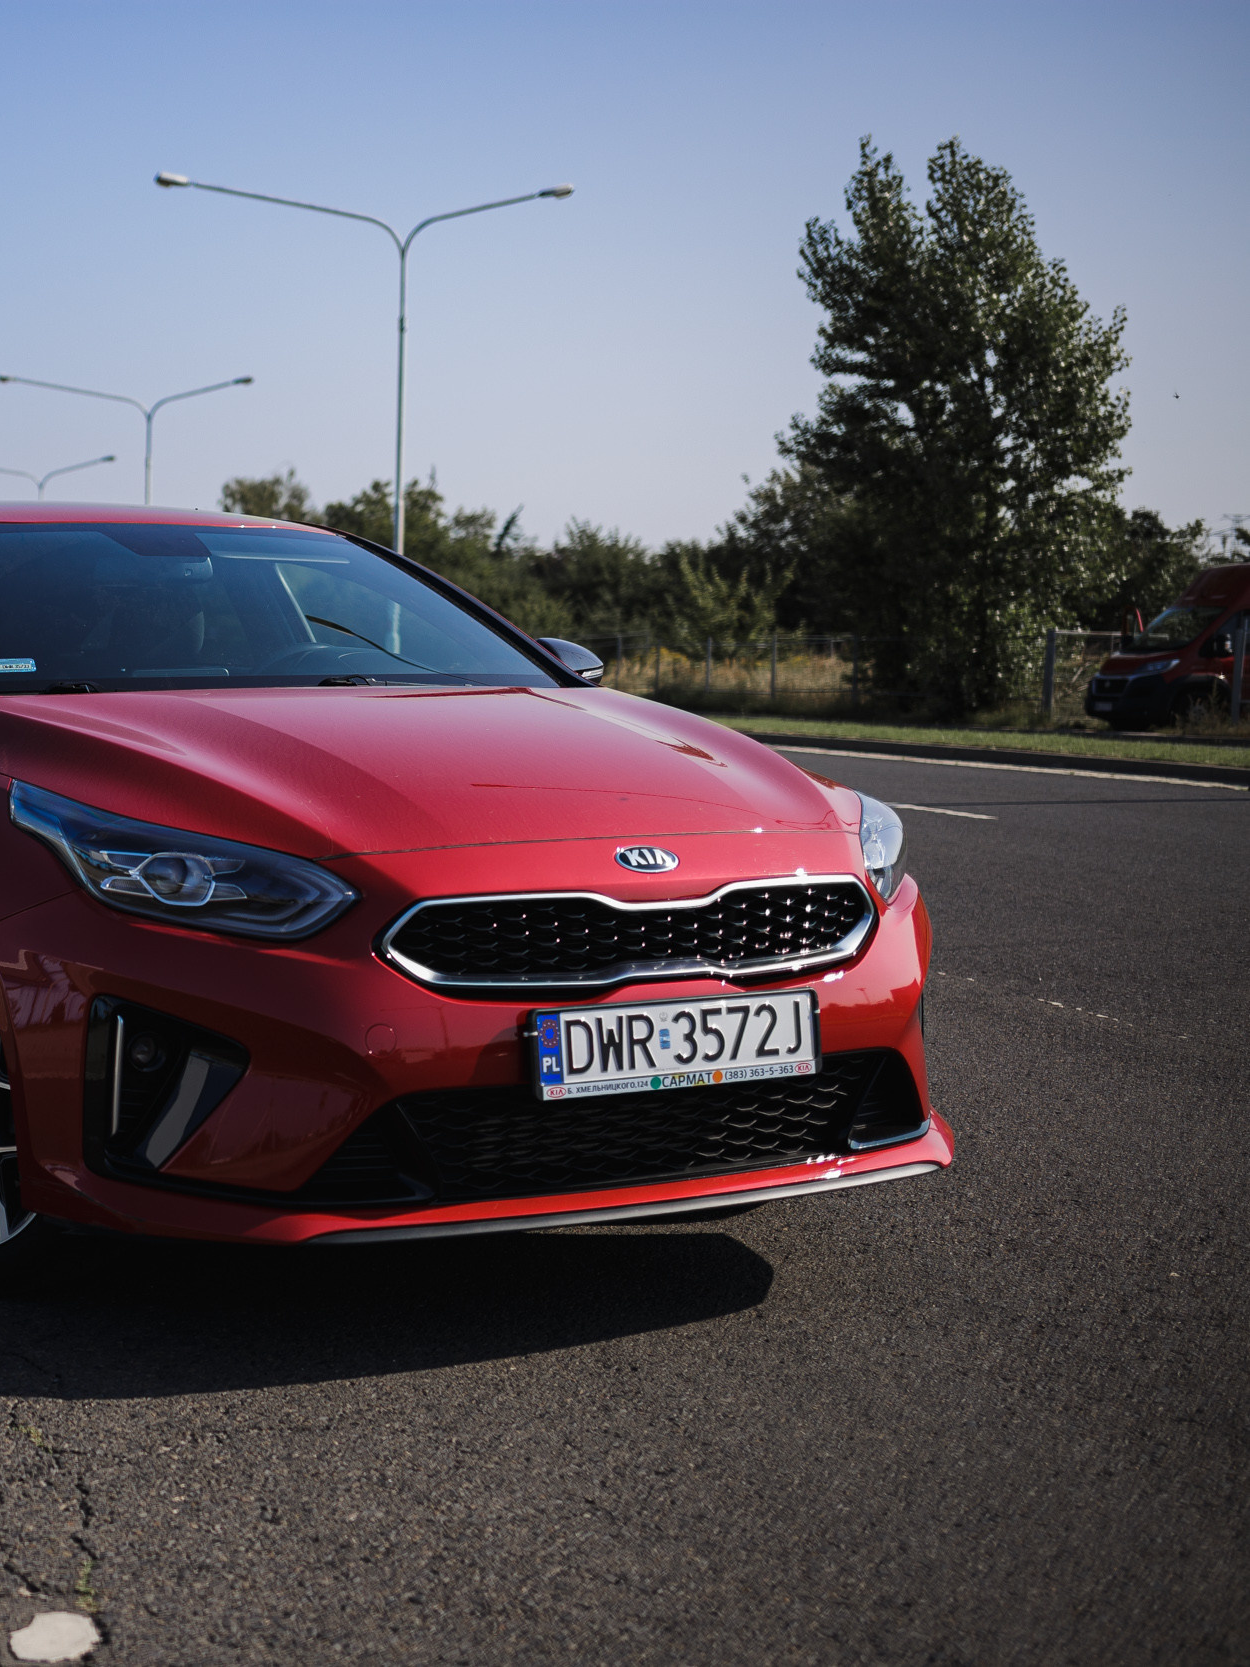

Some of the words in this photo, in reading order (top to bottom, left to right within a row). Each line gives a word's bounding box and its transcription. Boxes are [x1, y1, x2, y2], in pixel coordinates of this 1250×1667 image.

[624, 848, 676, 867] KIA
[565, 1013, 656, 1075] DWR
[672, 1000, 802, 1065] 3572J
[542, 1056, 561, 1073] PL
[724, 1069, 747, 1081] (383)
[749, 1065, 794, 1078] 363-5-363
[662, 1073, 712, 1087] САРМАТ
